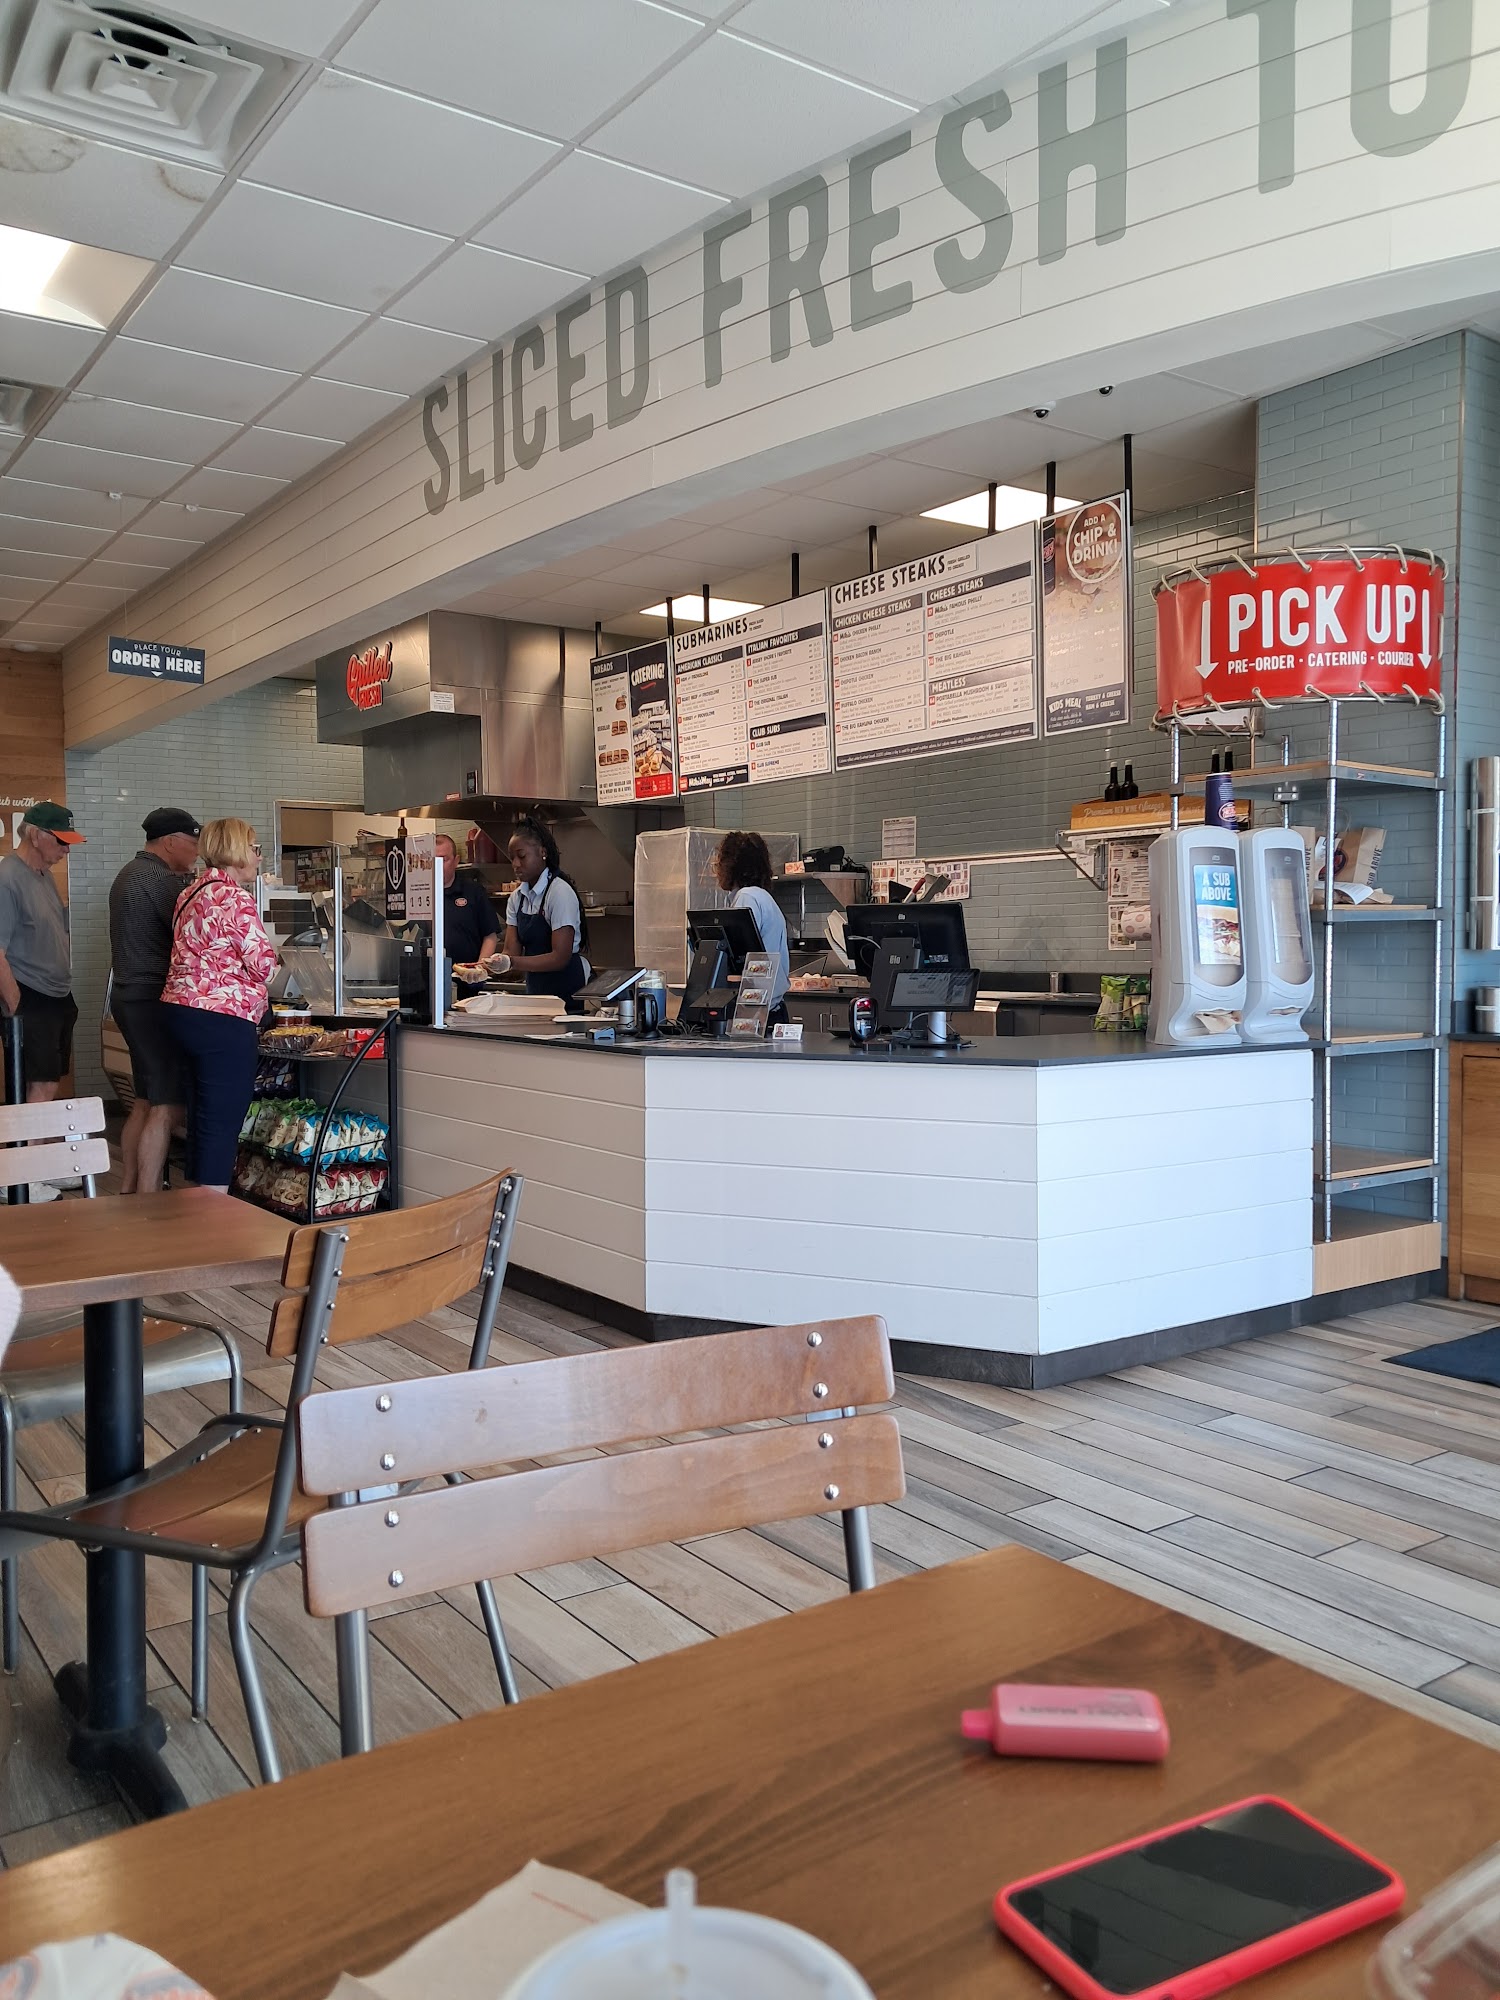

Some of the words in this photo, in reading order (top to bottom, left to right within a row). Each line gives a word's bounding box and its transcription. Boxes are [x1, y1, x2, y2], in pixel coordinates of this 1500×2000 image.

[421, 265, 650, 516] SLICED
[703, 37, 1128, 389] FRESH
[1084, 516, 1099, 527] ADD
[1100, 514, 1106, 522] A
[1074, 526, 1102, 546] CHIP
[1108, 522, 1116, 537] &
[1073, 539, 1118, 564] DRINK!
[835, 574, 885, 604] CHEESE
[892, 555, 944, 587] STEAKS
[930, 587, 956, 602] CHEESE
[958, 577, 984, 592] STEAKS
[949, 600, 966, 609] FAMOUS
[968, 595, 982, 604] PHILLY
[836, 612, 860, 628] CHICKEN
[862, 605, 886, 621] CHEESE
[888, 599, 912, 614] STEAKS
[1229, 585, 1347, 652] PICK
[1366, 584, 1416, 643] UP
[676, 618, 748, 652] SUBMARINES
[852, 628, 868, 636] CHICKEN
[935, 629, 954, 638] CHIPOTLE
[160, 646, 181, 656] YOUR
[748, 642, 768, 654] ITALIAN
[769, 632, 798, 647] FAVORITES
[112, 649, 160, 668] ORDER
[166, 657, 202, 674] HERE
[594, 662, 613, 674] BREADS
[677, 662, 701, 673] AMERICAN
[702, 654, 723, 666] CLASSICS
[1228, 654, 1294, 675] PRE-ORDER
[1308, 652, 1367, 667] CATERING
[1378, 652, 1414, 667] COURIER
[631, 663, 665, 686] CATERING!
[932, 677, 966, 692] MEATLESS
[936, 692, 962, 701] PORTABELLA
[964, 686, 989, 695] MUSHROOM
[1049, 699, 1064, 713] KIDS
[1065, 698, 1081, 708] MEAL
[752, 728, 765, 737] CLUB
[767, 724, 780, 734] SUBS
[1084, 807, 1113, 818] Premium
[1138, 801, 1165, 812] Vinegar
[1371, 848, 1382, 871] ABOVE
[1203, 872, 1209, 885] A
[1213, 872, 1230, 886] SUB
[410, 897, 414, 907] 1
[426, 896, 430, 906] 5
[1202, 887, 1232, 900] ABOVE
